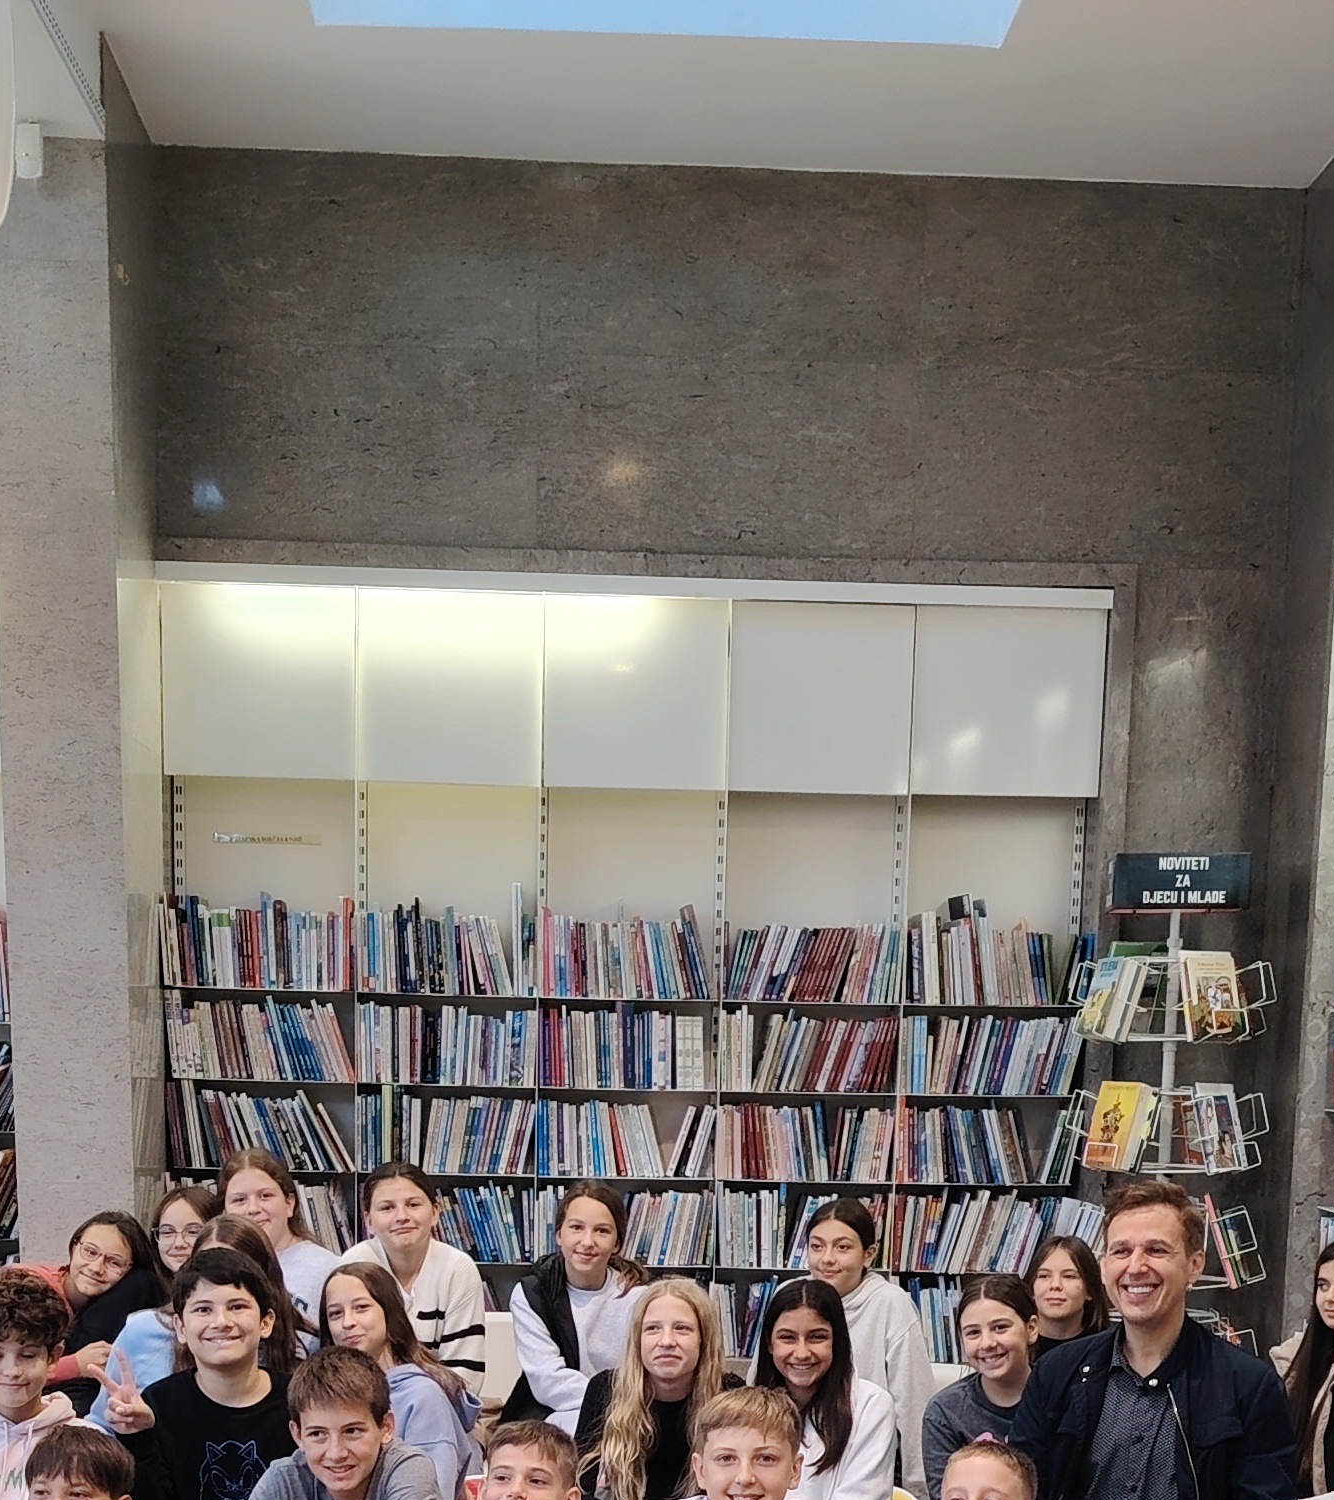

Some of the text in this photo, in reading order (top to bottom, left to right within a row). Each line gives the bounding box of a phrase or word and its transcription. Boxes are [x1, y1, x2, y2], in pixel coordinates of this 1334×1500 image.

[1158, 857, 1210, 871] NOVITETI
[1175, 874, 1191, 888] ZA
[1142, 891, 1227, 904] DJECU I MLADE
